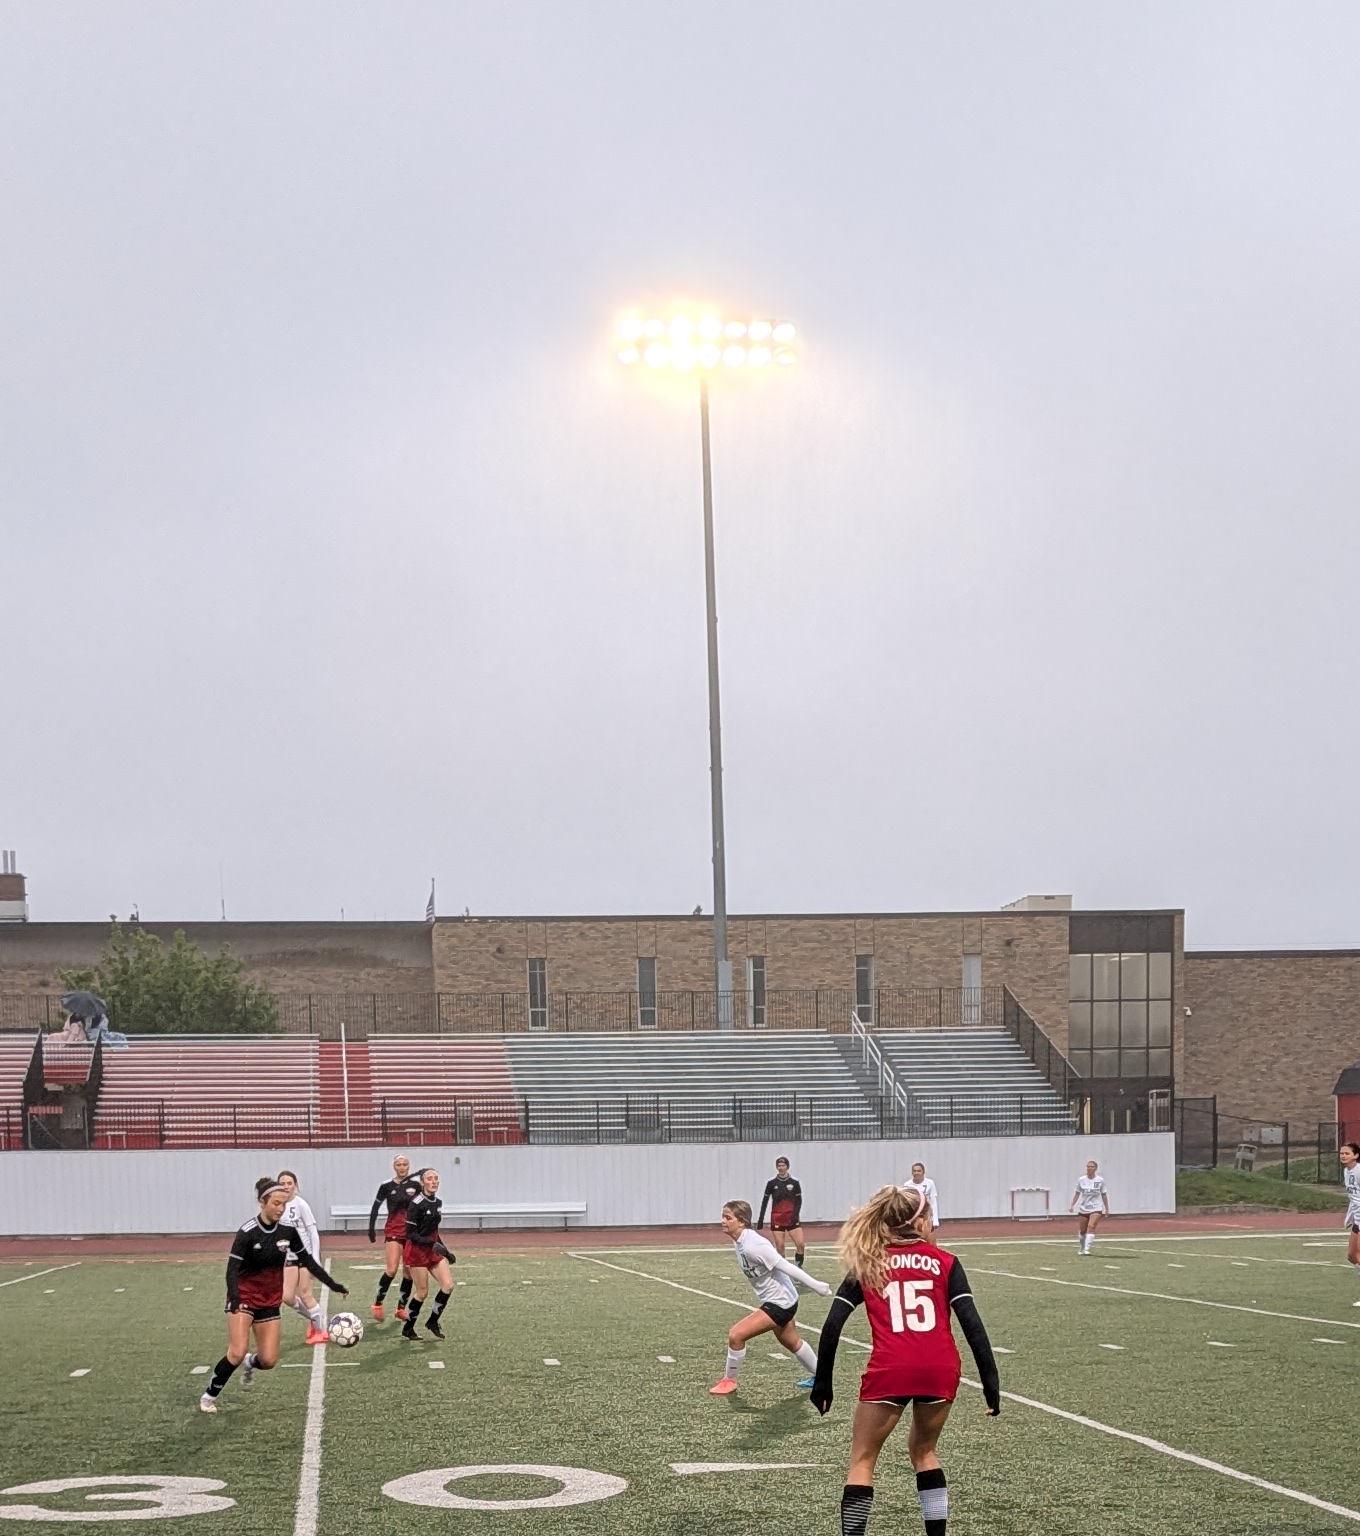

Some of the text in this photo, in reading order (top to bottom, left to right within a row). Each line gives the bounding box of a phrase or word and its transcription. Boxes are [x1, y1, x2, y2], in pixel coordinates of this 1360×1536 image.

[289, 1206, 296, 1219] 5
[885, 1253, 941, 1276] ONCOS
[883, 1279, 936, 1333] 15
